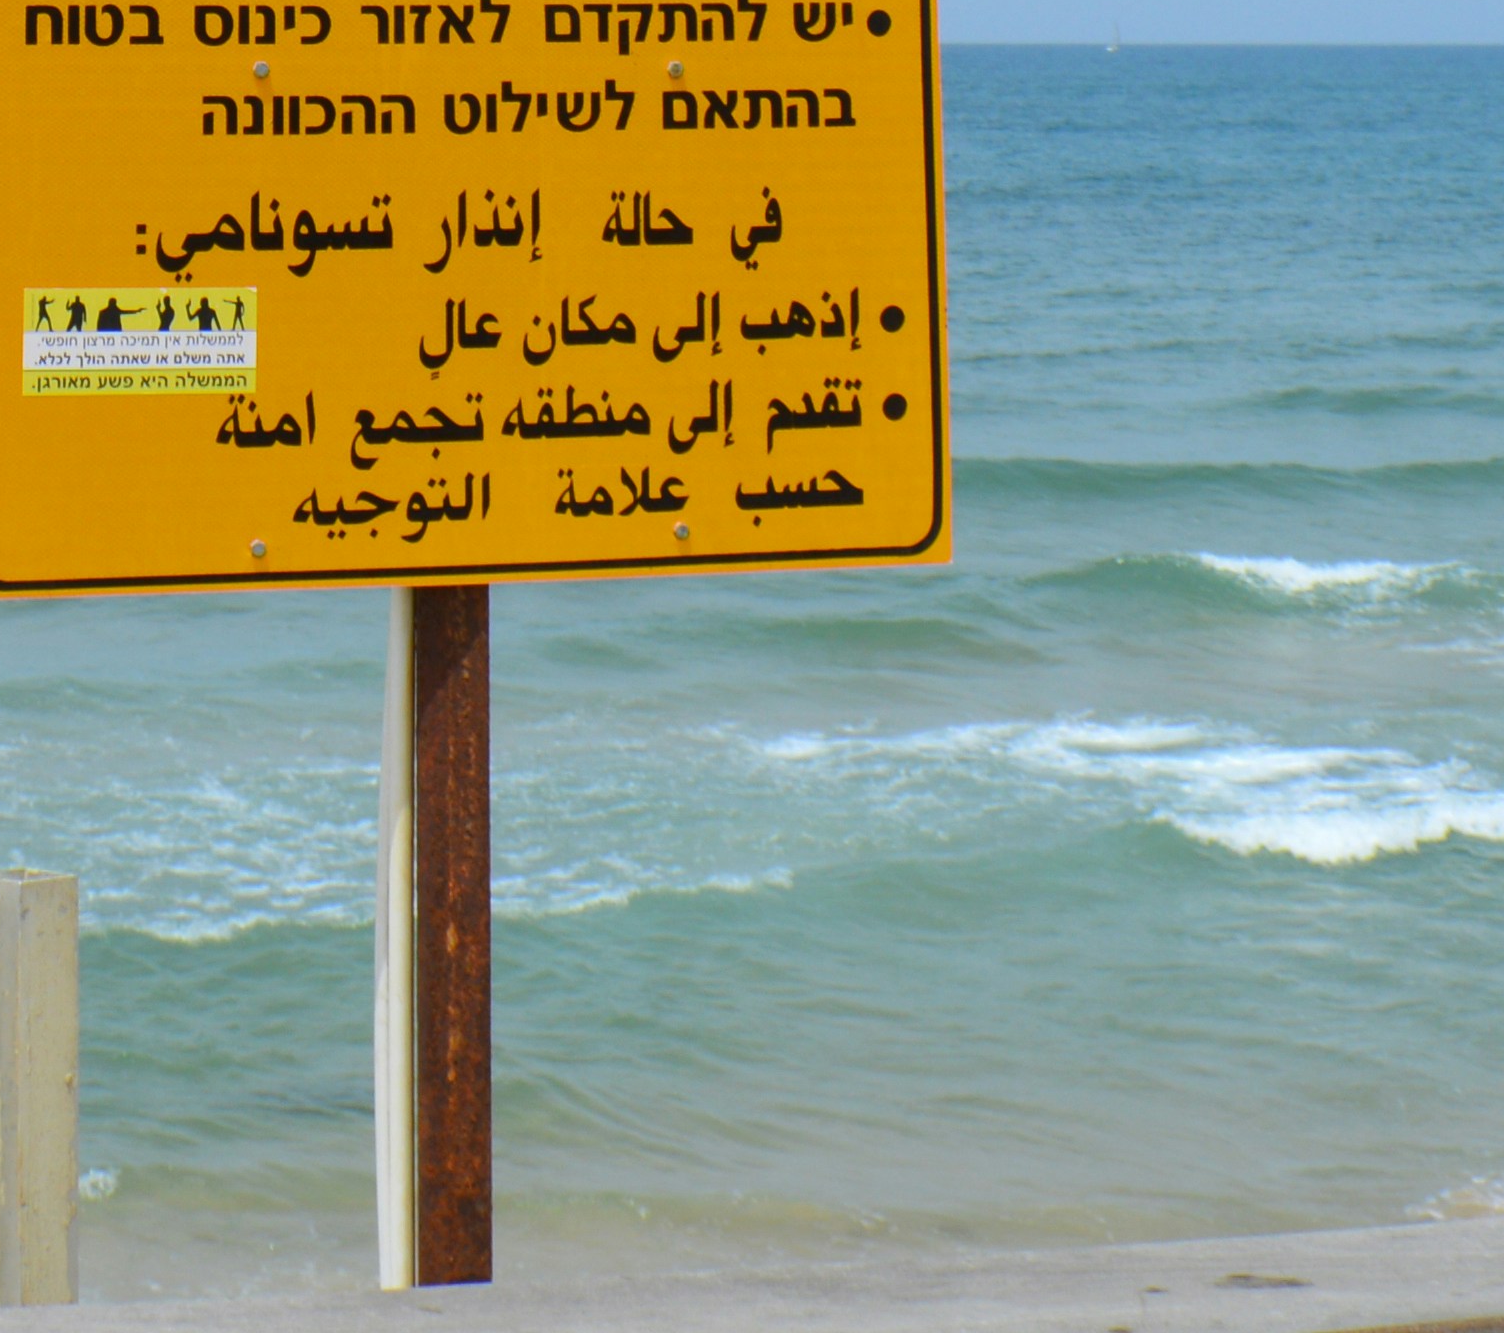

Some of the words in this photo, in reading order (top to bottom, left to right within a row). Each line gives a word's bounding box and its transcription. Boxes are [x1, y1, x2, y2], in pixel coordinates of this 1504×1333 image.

[25, 5, 164, 47] בטוח
[194, 5, 332, 47] כינוס
[793, 3, 853, 42] יש
[202, 95, 416, 135] ההכוונה
[444, 80, 635, 135] לשילוט
[663, 89, 856, 131] בהתאם
[136, 193, 393, 283] تسونامي:
[424, 190, 542, 273] إنذار
[602, 192, 693, 246] حالة
[731, 187, 782, 270] في
[82, 335, 115, 349] מרצון
[120, 335, 160, 347] תמיכה
[164, 335, 181, 349] אין
[186, 333, 244, 346] לממשלות
[523, 296, 636, 366] مكان
[653, 292, 721, 363] إلى
[740, 288, 861, 355] إذهب
[76, 351, 106, 368] הולך
[110, 353, 151, 364] שאתה
[155, 353, 169, 364] או
[173, 351, 212, 364] משלם
[216, 352, 245, 364] אתה
[31, 375, 91, 393] מאורגן.
[97, 375, 134, 389] פשע
[140, 375, 168, 388] היא
[175, 371, 247, 388] הממשלה
[216, 391, 316, 448] امنة
[351, 392, 484, 470] تجمع
[502, 386, 651, 440] منطقه
[668, 380, 733, 455] إلى
[767, 377, 862, 454] تقدم
[293, 473, 490, 543] التوجيه
[555, 468, 688, 517] علامة
[735, 470, 864, 526] حسب
